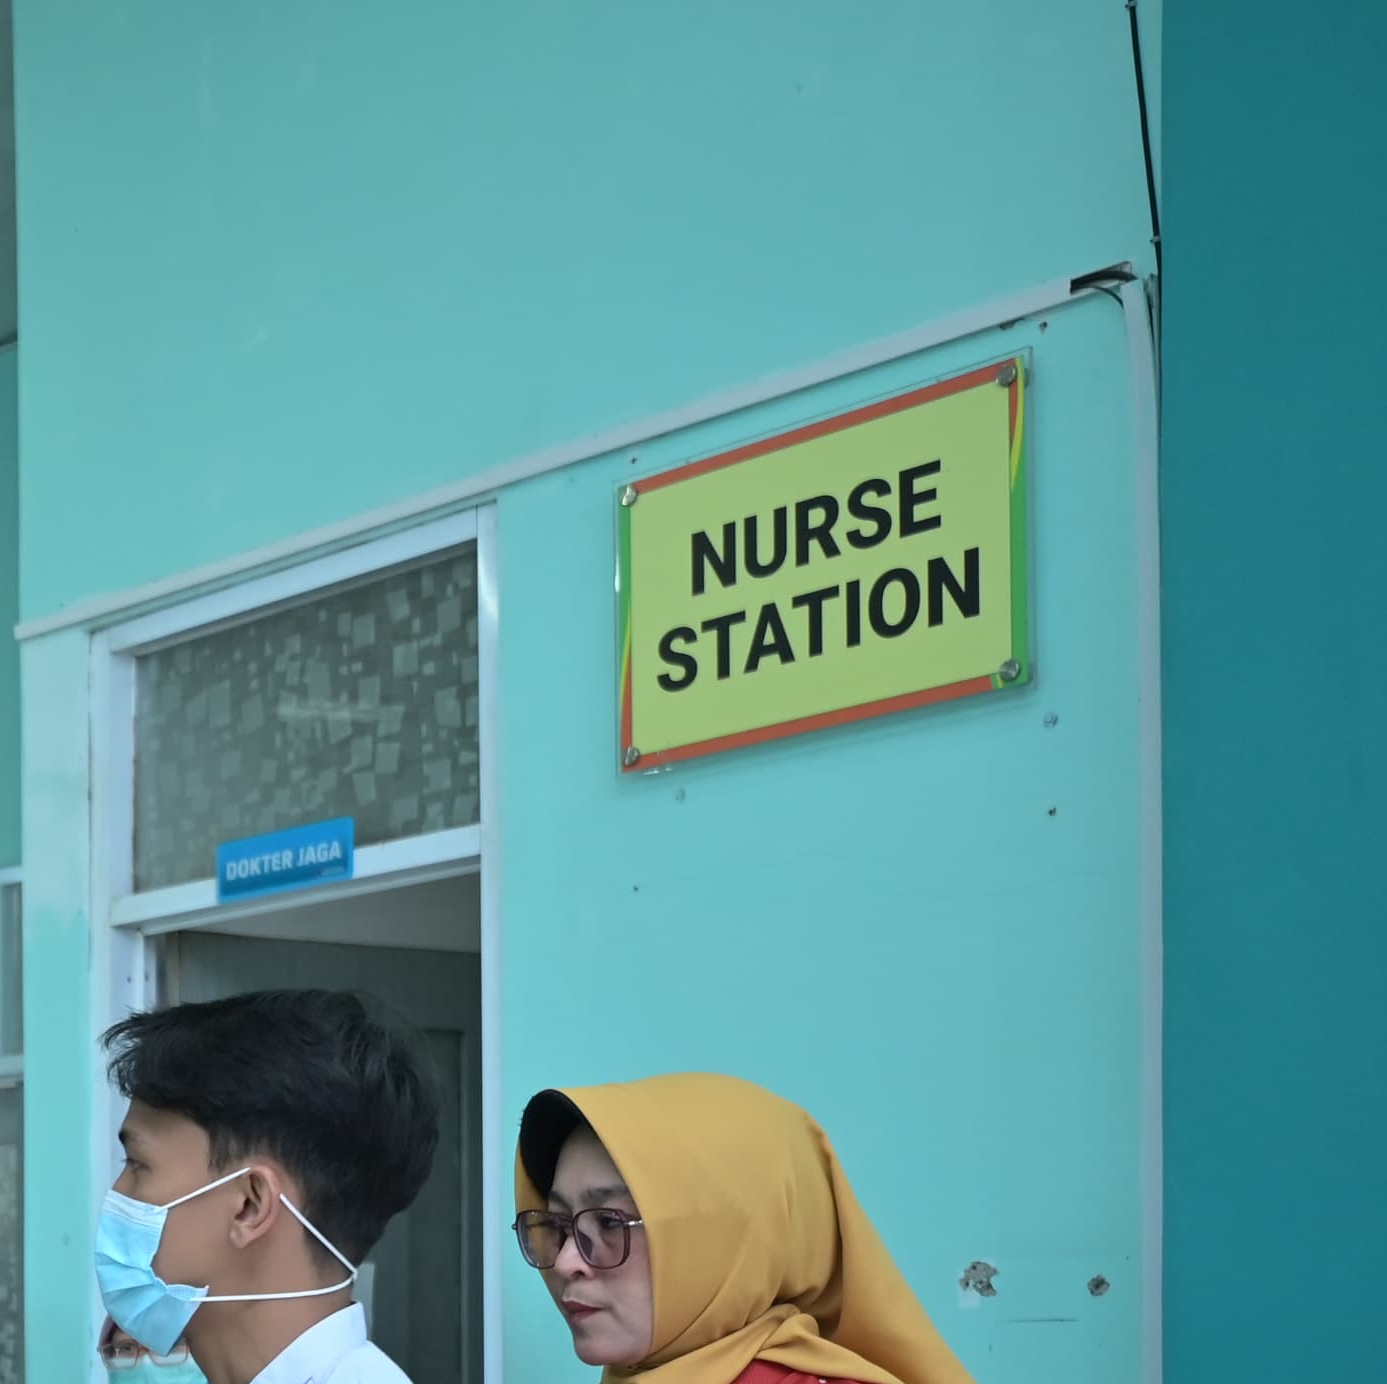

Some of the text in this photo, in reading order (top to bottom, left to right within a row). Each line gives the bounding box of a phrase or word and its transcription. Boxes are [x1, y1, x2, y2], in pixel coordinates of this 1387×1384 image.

[691, 459, 941, 597] NURSE
[657, 547, 980, 693] STATION
[226, 849, 292, 881] DOKTER
[297, 841, 342, 866] JAGA
